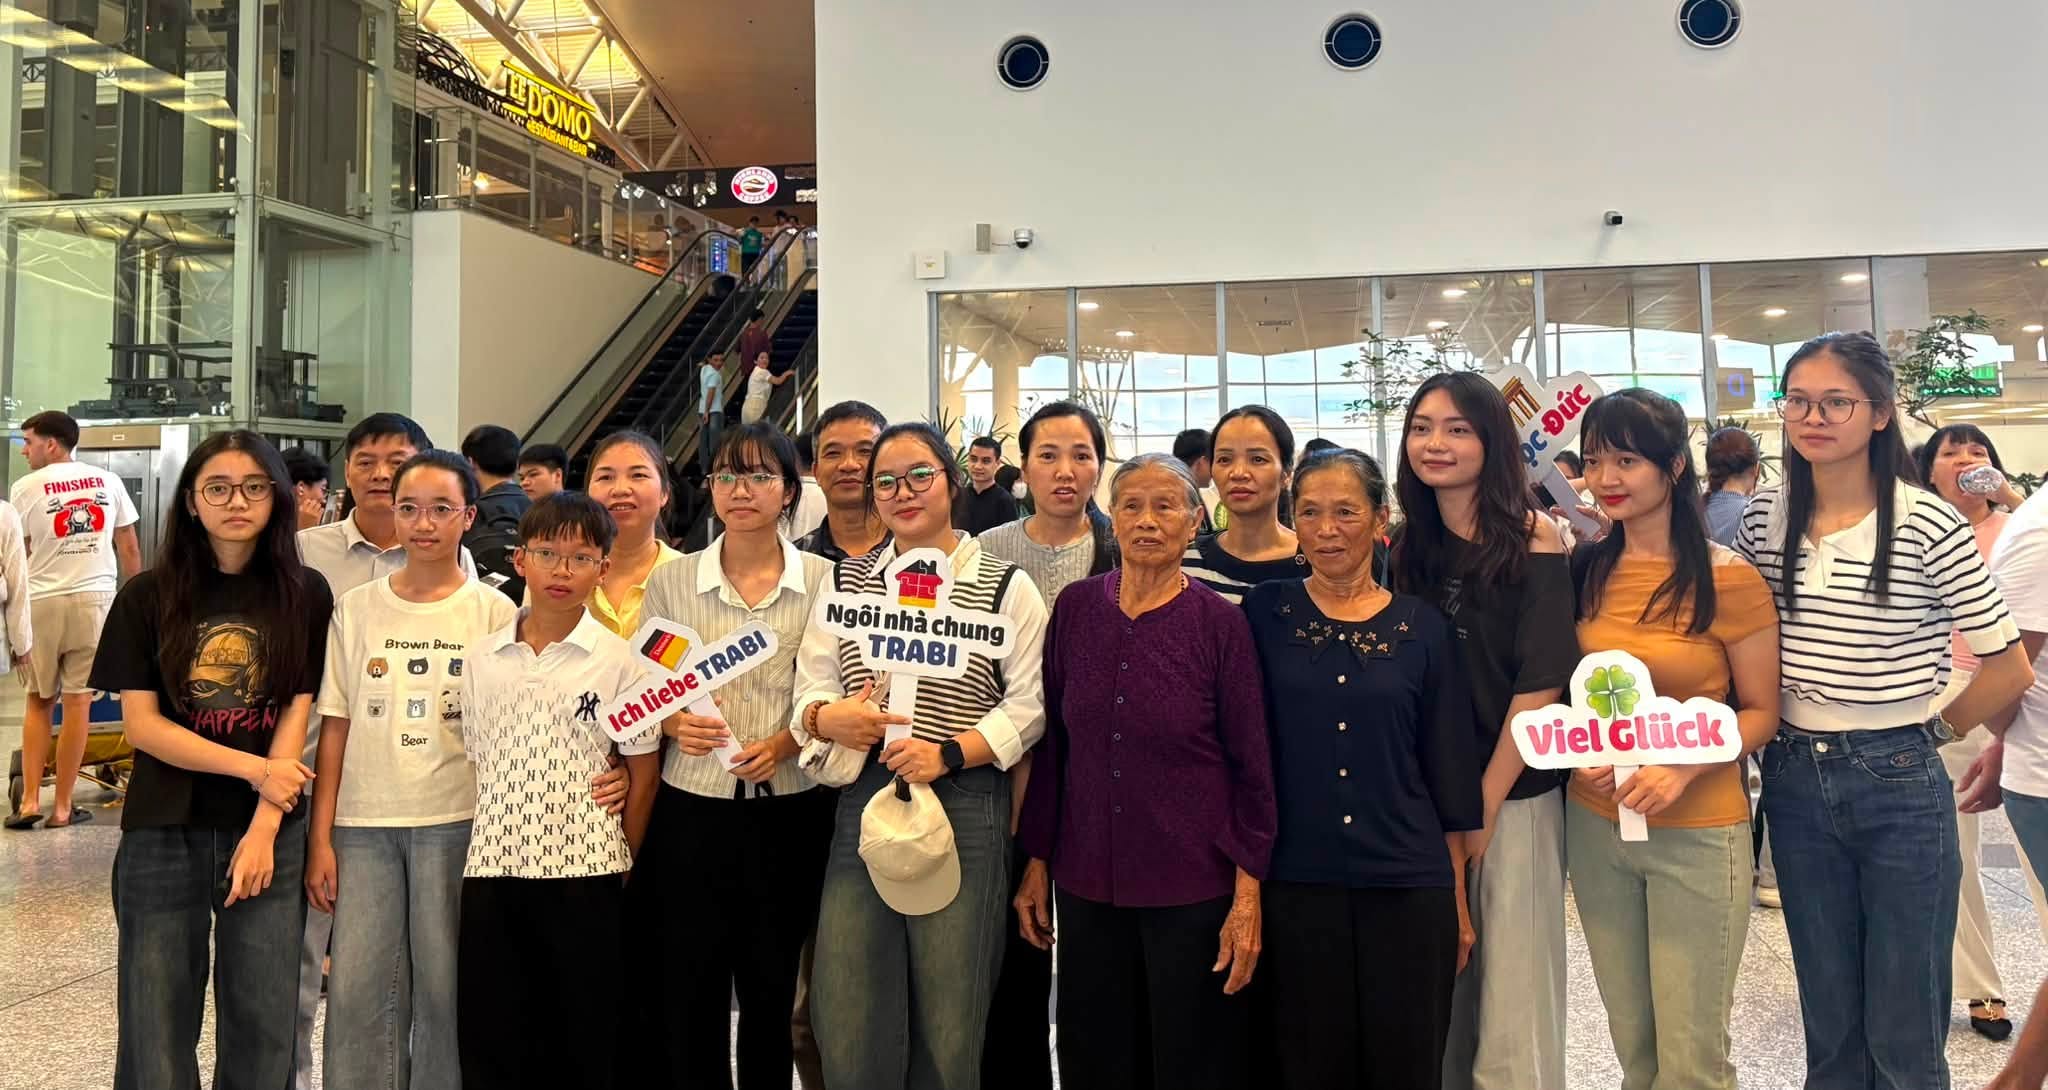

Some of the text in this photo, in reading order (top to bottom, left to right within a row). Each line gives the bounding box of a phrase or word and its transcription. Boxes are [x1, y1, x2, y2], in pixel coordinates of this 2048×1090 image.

[528, 85, 591, 141] DOMO
[1520, 384, 1592, 467] ọc Đức
[44, 477, 104, 495] FINISHER
[385, 639, 464, 651] Brown Bear
[827, 603, 1005, 646] Ngôi nhà chung
[868, 634, 957, 667] TRABI
[608, 630, 768, 733] Ich liebe TRABI
[401, 734, 428, 746] Bear
[1526, 712, 1725, 755] Viel Glück
